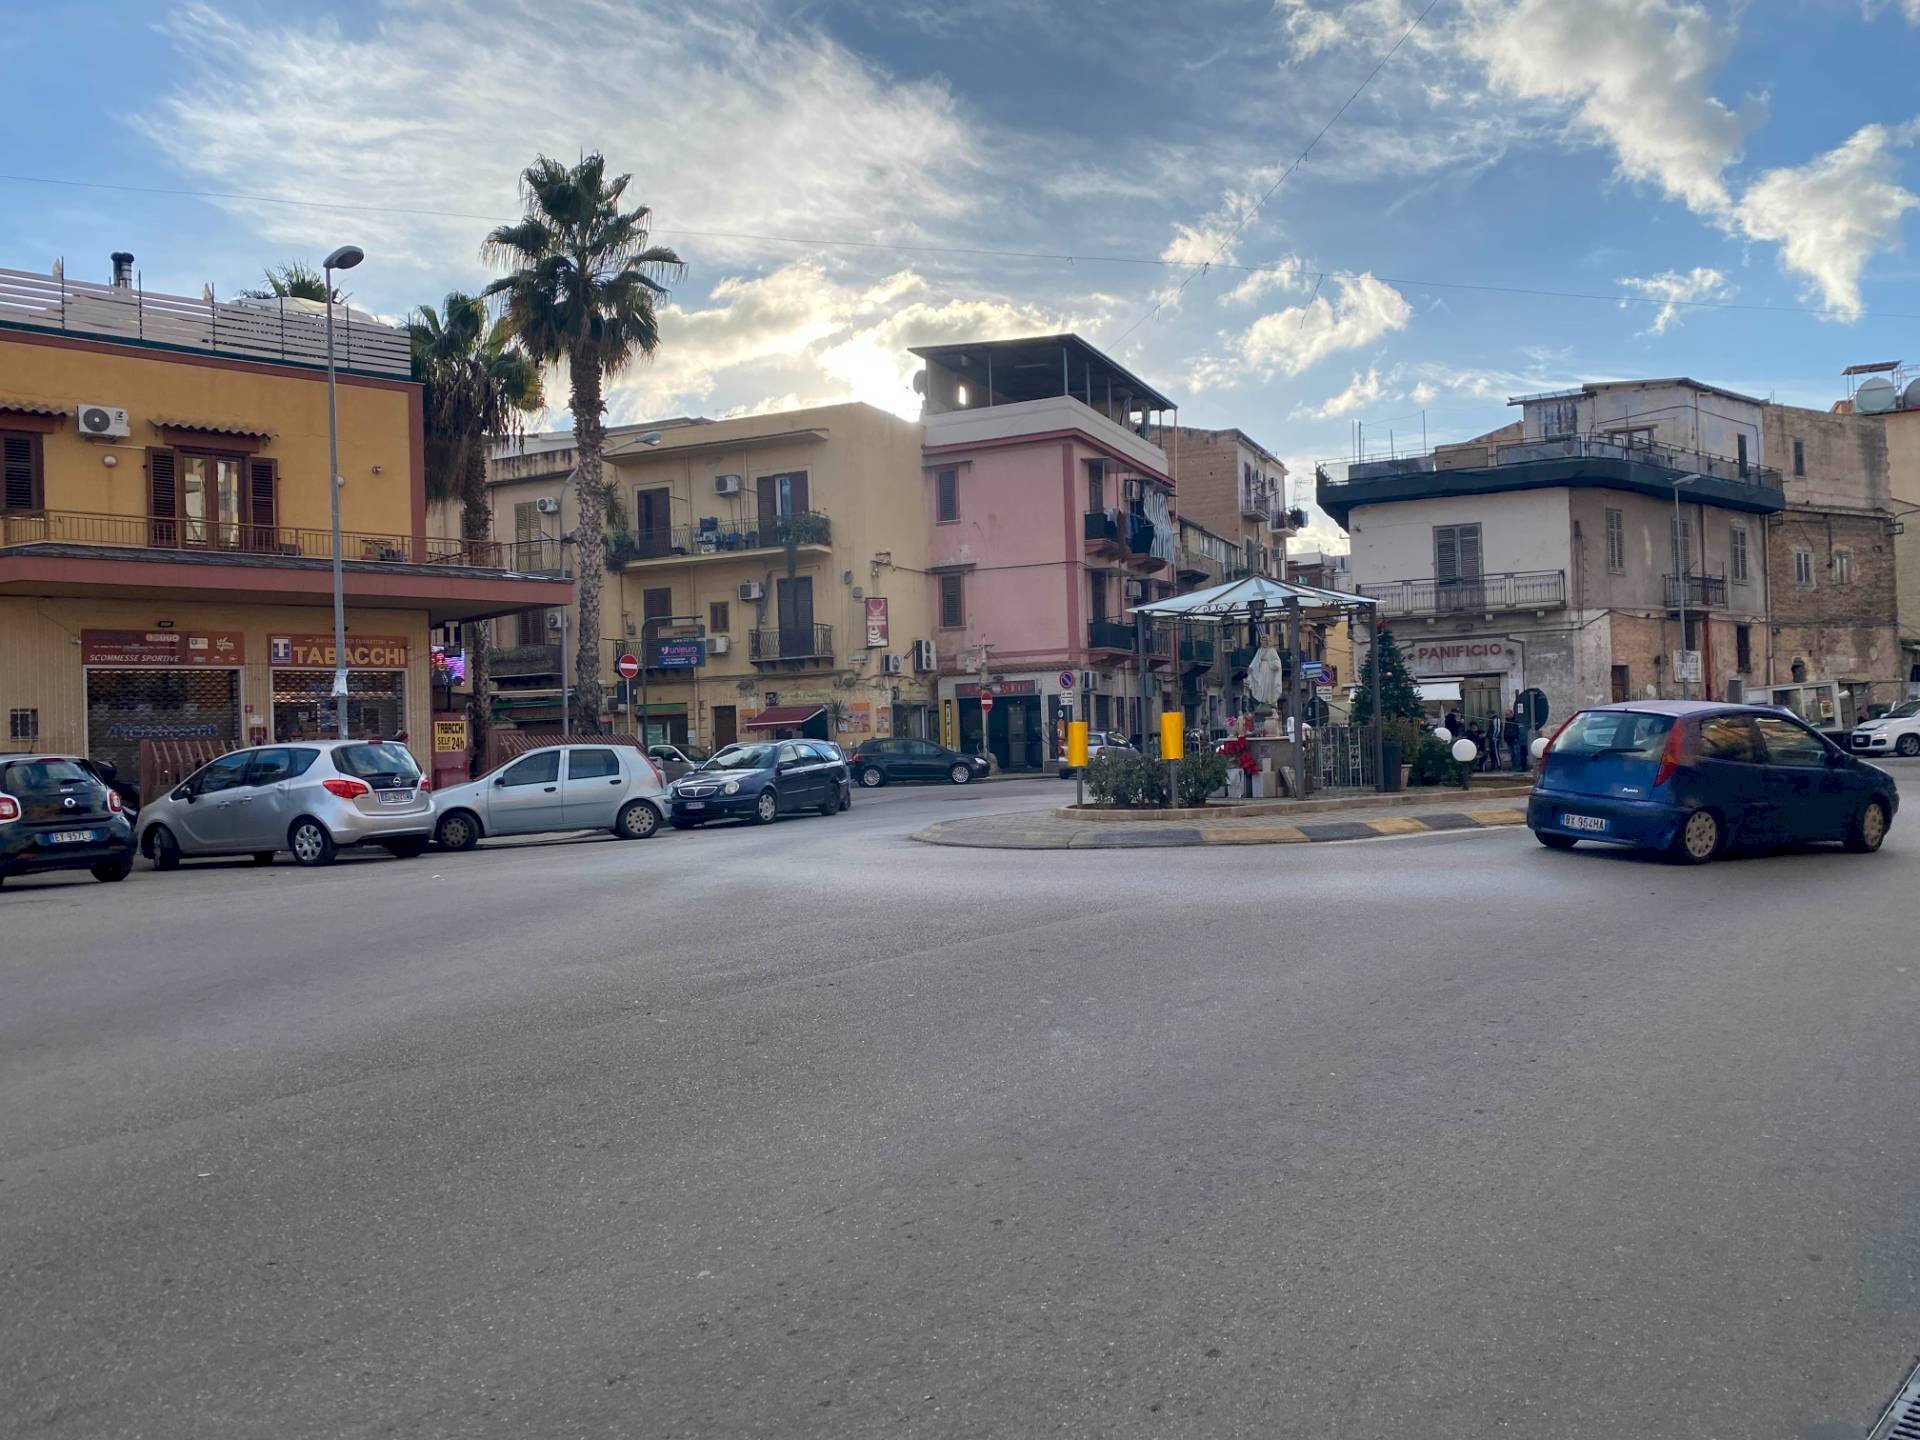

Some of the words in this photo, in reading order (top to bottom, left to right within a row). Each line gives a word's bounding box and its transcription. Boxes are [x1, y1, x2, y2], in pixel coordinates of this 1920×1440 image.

[445, 621, 459, 647] T
[273, 638, 288, 657] T
[669, 645, 698, 654] unieuro
[1418, 643, 1502, 659] PANIFICIO
[89, 654, 139, 662] SCOMMESSE
[292, 646, 406, 665] TABACCHI
[436, 722, 465, 735] TABACCHI
[437, 736, 451, 745] SELF
[451, 737, 465, 751] 24h
